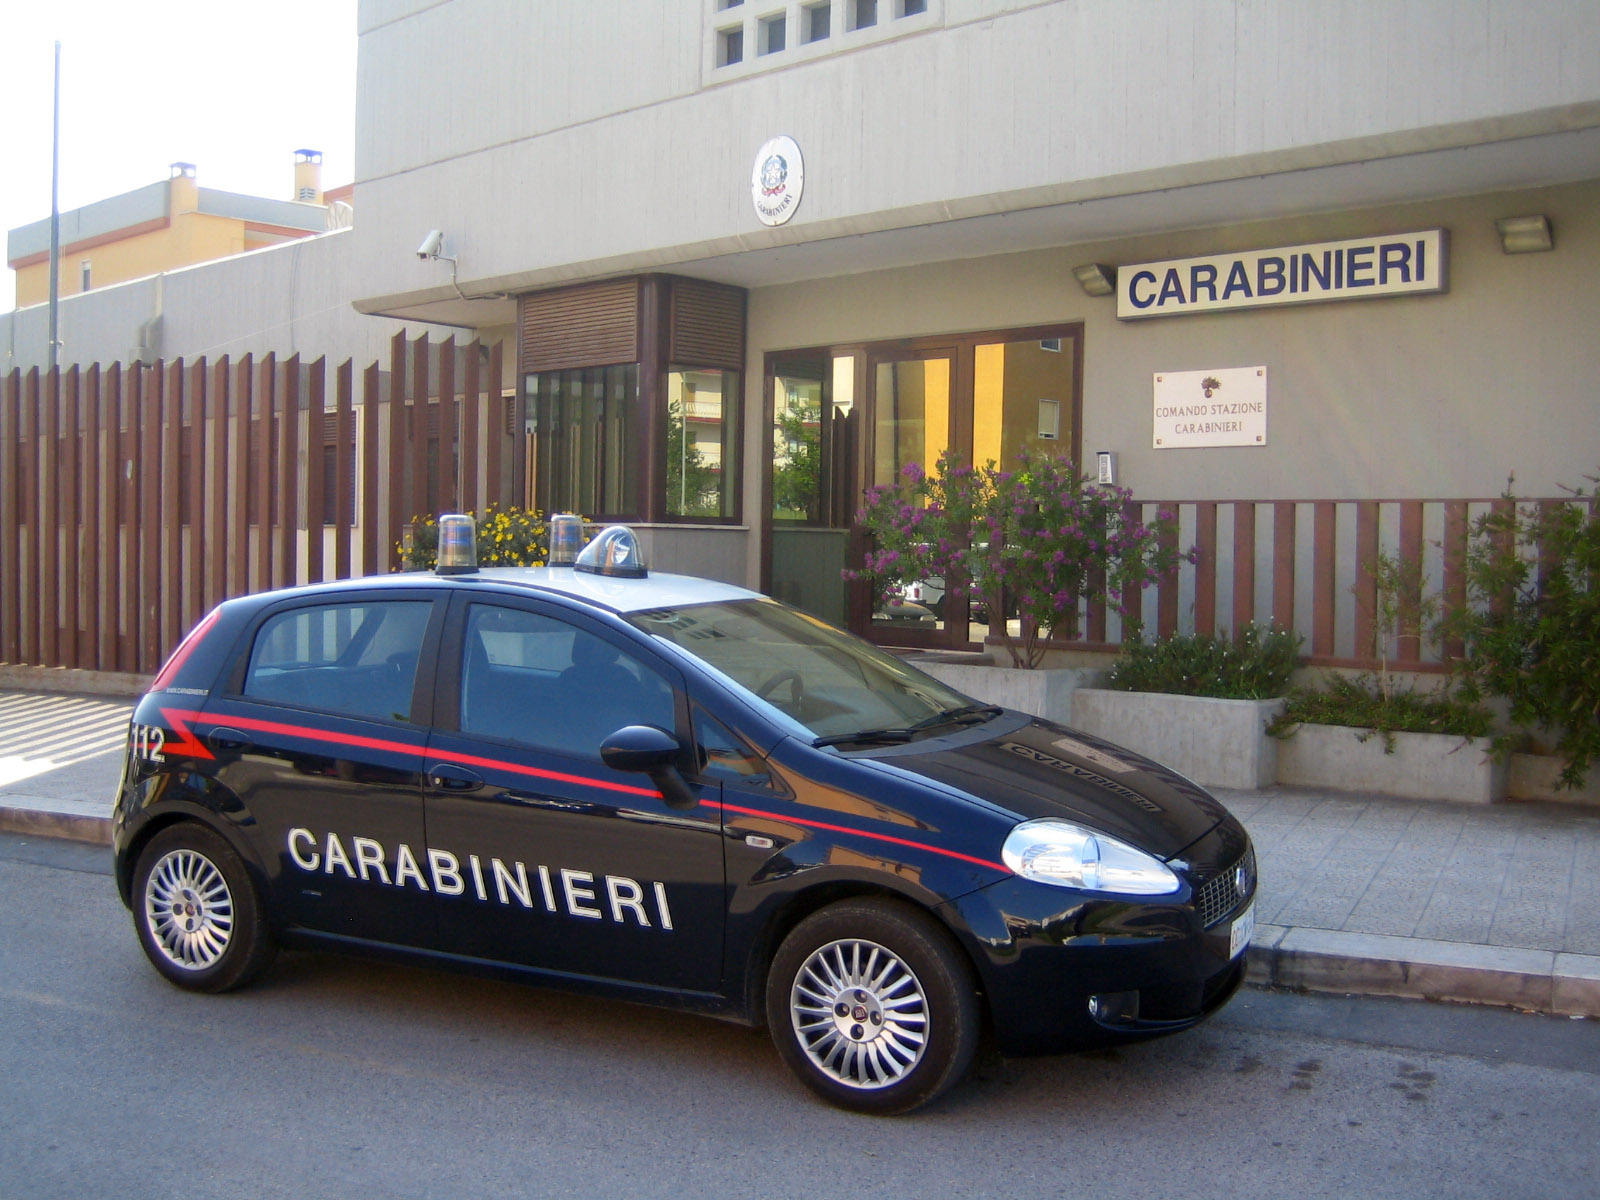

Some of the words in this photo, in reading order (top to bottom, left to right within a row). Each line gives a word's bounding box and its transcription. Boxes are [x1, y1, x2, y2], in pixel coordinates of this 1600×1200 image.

[757, 194, 793, 216] CARABINIERI
[1128, 239, 1425, 309] CARABINIERI
[1155, 404, 1208, 418] COMANDO
[1210, 402, 1264, 415] STAZIONE
[1174, 421, 1243, 435] CARABINIERI
[132, 723, 166, 763] 112
[287, 827, 674, 931] CARABINIERI
